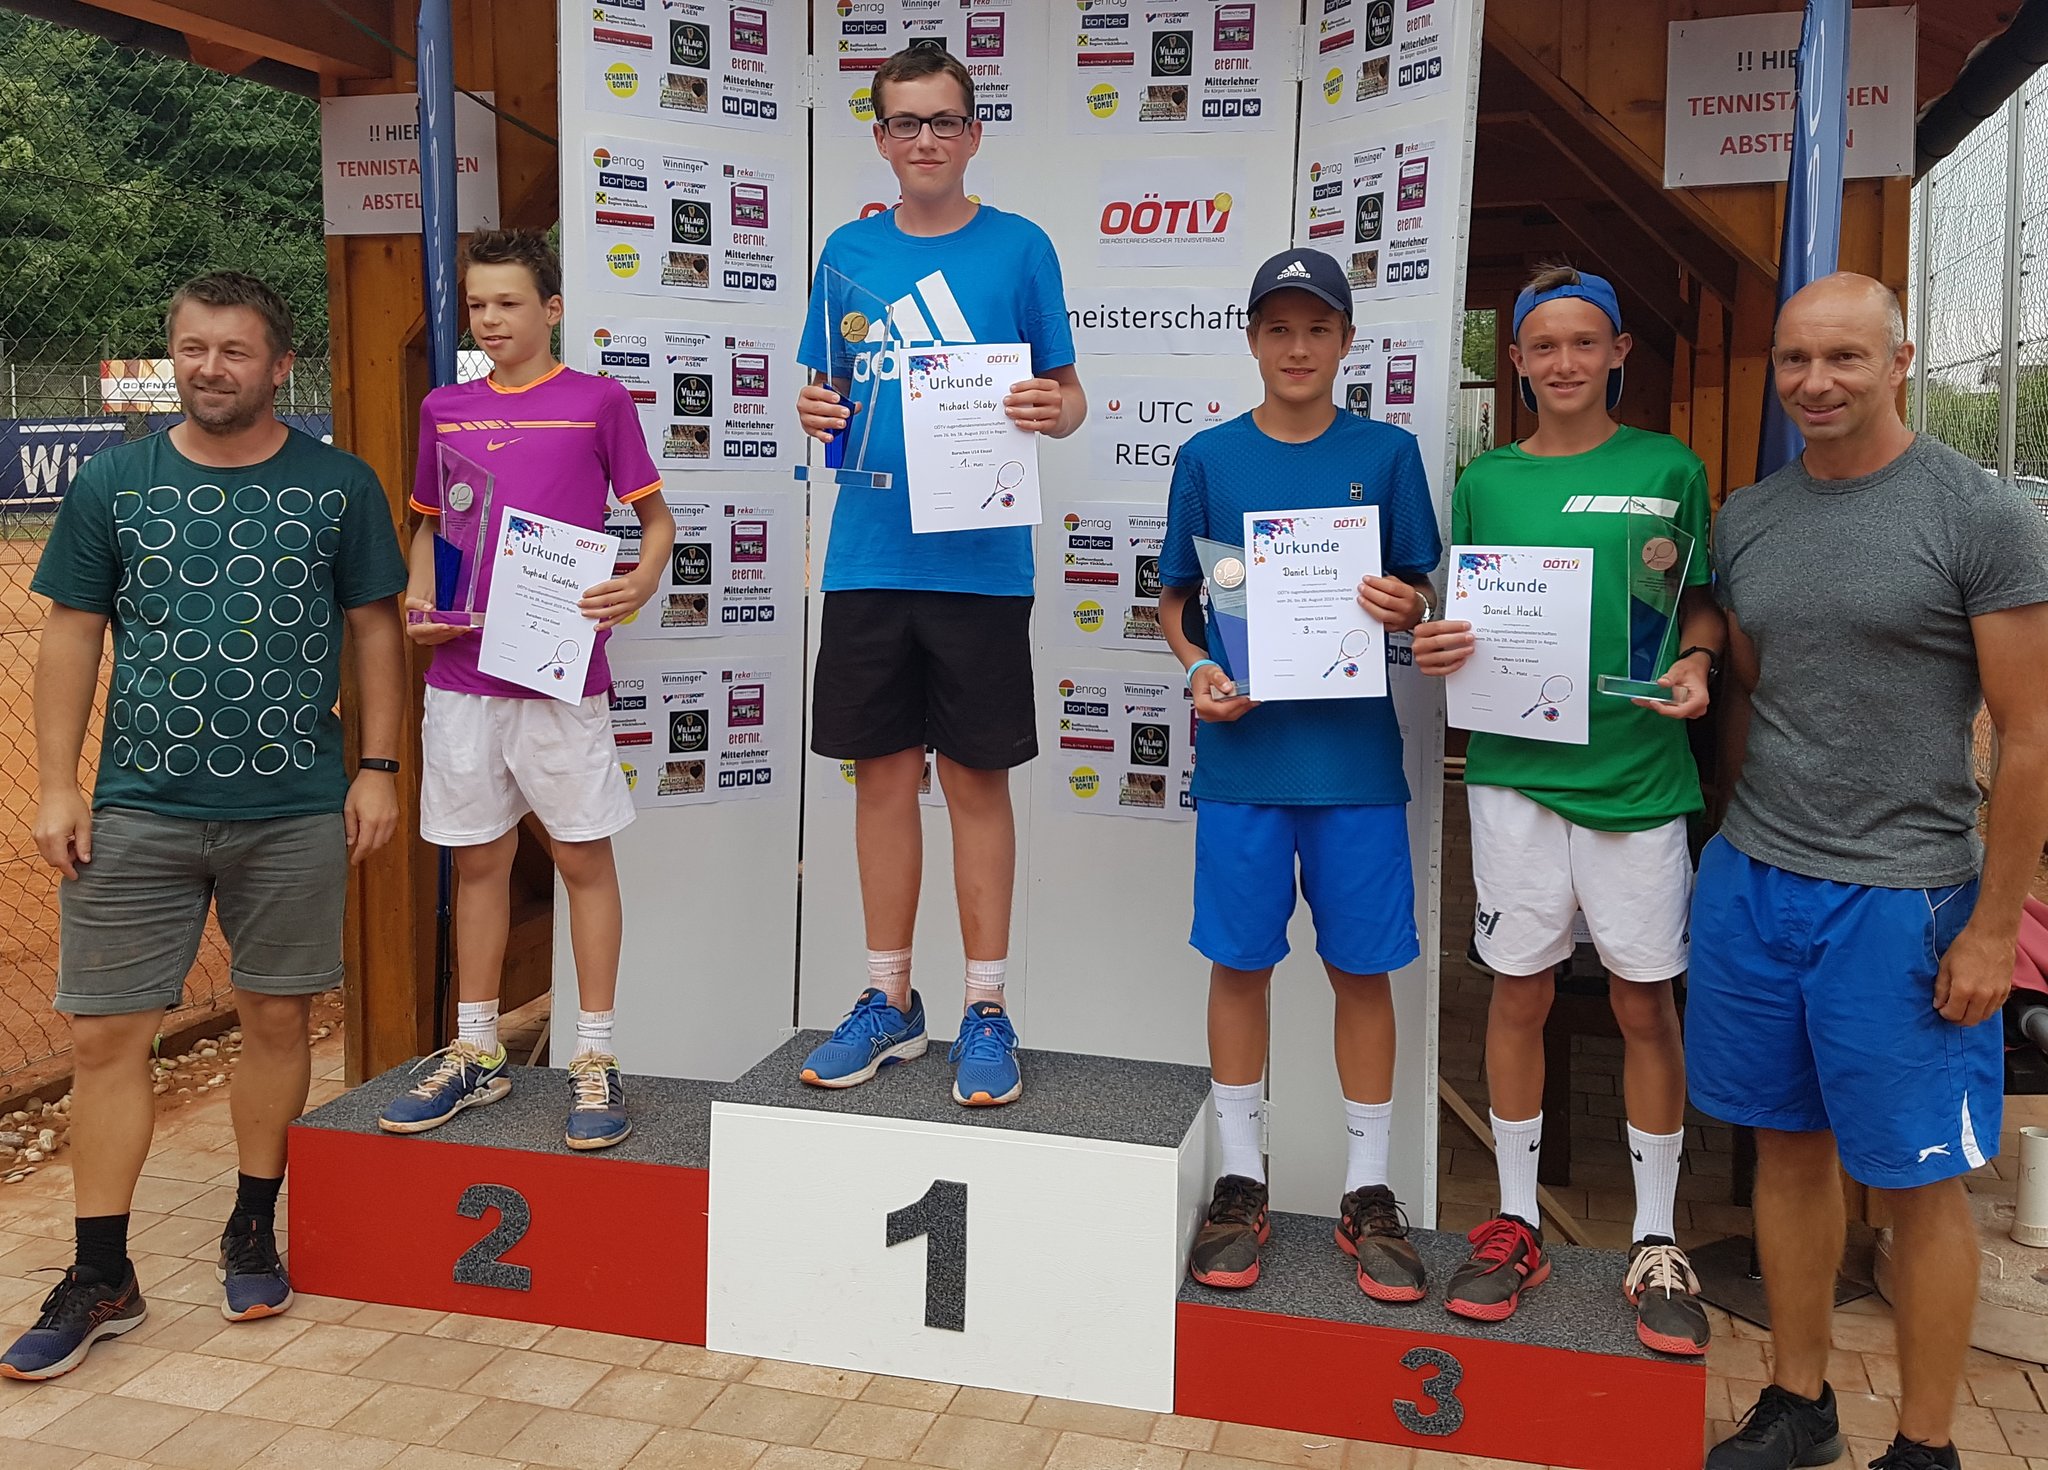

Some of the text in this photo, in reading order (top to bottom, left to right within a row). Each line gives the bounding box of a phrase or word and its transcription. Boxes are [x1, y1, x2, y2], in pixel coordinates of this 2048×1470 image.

[852, 3, 885, 15] enrag
[677, 35, 703, 48] VILLAGE
[683, 45, 698, 57] HILL
[1160, 45, 1186, 57] VILLAGE
[731, 57, 765, 74] eternit
[1164, 54, 1179, 65] HILL
[1214, 57, 1251, 71] eternit
[1761, 49, 1799, 70] HIE
[722, 74, 774, 90] Mitterlehner
[974, 82, 1009, 92] erlehner
[1204, 76, 1260, 87] Mitterlehner
[725, 99, 757, 116] HI PI
[1205, 103, 1238, 114] HI PI
[337, 156, 479, 177] TENNISTAEN
[611, 155, 645, 171] enrag
[662, 158, 704, 174] Winninger
[362, 193, 422, 210] ABSTEL
[679, 213, 705, 226] VILLAGE
[684, 223, 699, 235] HILL
[733, 232, 766, 247] eternit
[1389, 237, 1429, 250] Mitterlehner
[724, 248, 775, 262] Mitterlehner
[1277, 270, 1312, 280] adidas
[1388, 266, 1414, 281] HI PI
[726, 274, 757, 288] HI PI
[612, 333, 648, 349] enrag
[664, 334, 705, 348] Winninger
[929, 373, 994, 391] Urkunde
[680, 388, 706, 400] VILLAGE
[686, 397, 701, 408] HILL
[733, 402, 766, 416] eternit
[939, 400, 998, 412] Michael Slaby
[1138, 401, 1193, 424] UTC
[725, 420, 774, 433] Mitterlehner
[726, 443, 757, 456] HI PI
[20, 443, 93, 494] Wi
[667, 505, 704, 517] inninger
[1080, 518, 1112, 531] enrag
[1128, 517, 1167, 530] Winninge
[522, 541, 577, 568] Urkunde
[1273, 539, 1340, 556] Urkunde
[731, 568, 764, 580] eternit
[1282, 566, 1338, 580] Daniel Liebig
[723, 586, 773, 595] Mitterlehner
[1477, 578, 1548, 594] Urkunde
[724, 608, 755, 620] HI PI
[1482, 604, 1544, 618] Daniel Hackl
[661, 673, 702, 685] Winninger
[1075, 684, 1107, 698] enrag
[1124, 684, 1164, 698] Winninger
[728, 732, 761, 745] eternit
[720, 749, 770, 760] Mitterlehner
[720, 772, 751, 785] HI PI
[452, 1182, 532, 1293] 2
[885, 1177, 969, 1334] 1
[1391, 1345, 1466, 1437] 3
